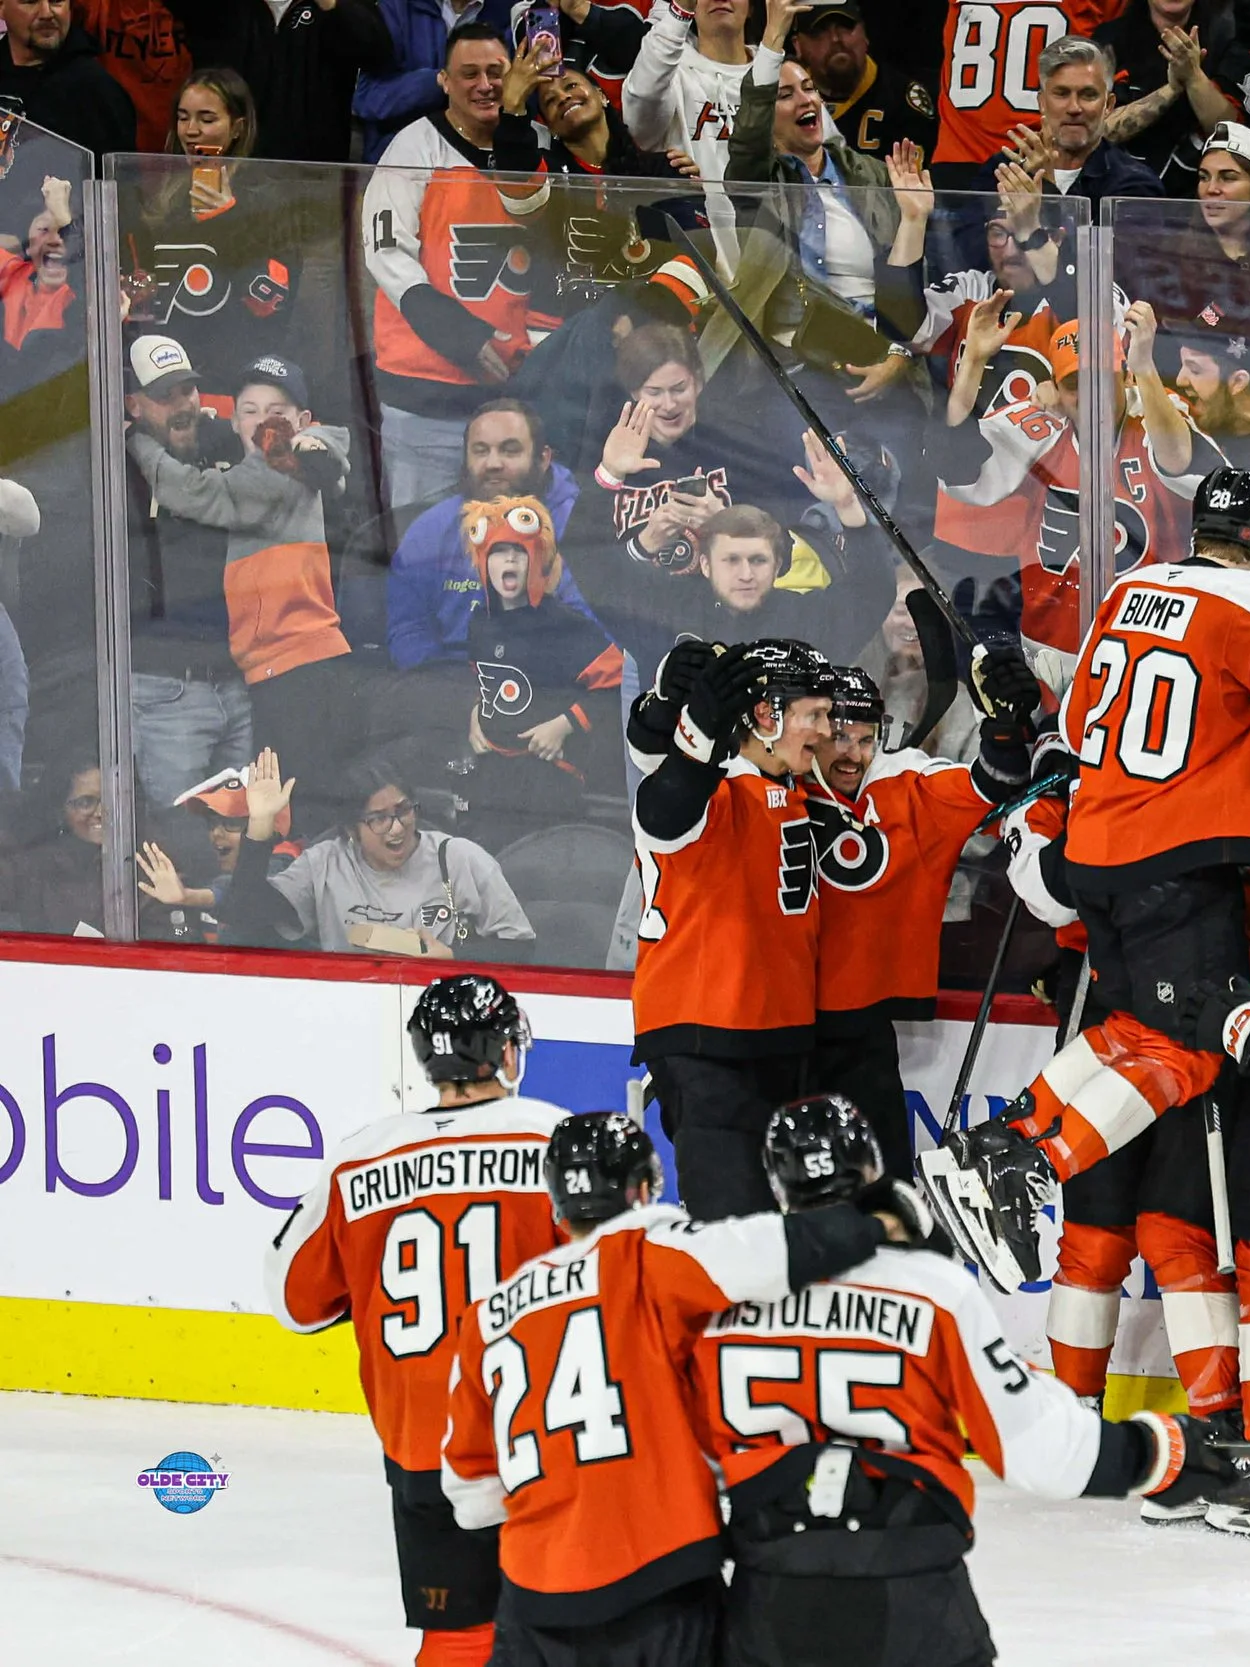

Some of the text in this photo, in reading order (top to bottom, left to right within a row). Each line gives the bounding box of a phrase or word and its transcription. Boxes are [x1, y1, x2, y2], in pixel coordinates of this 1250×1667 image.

[948, 2, 1070, 112] 80
[857, 108, 885, 149] C
[613, 467, 733, 540] FLYS
[1119, 457, 1147, 504] C
[1209, 489, 1232, 509] 20
[1120, 593, 1185, 631] BUMP
[1079, 632, 1202, 784] 20
[766, 788, 788, 809] IBX
[863, 792, 881, 828] A
[432, 1031, 454, 1055] 91
[0, 1033, 324, 1211] bile
[350, 1148, 540, 1212] GRUNDSTROM
[565, 1168, 592, 1195] 24
[804, 1152, 835, 1179] 55
[380, 1201, 502, 1361] 91
[488, 1259, 586, 1331] SEELER
[481, 1305, 635, 1496] 24
[718, 1343, 912, 1453] 55
